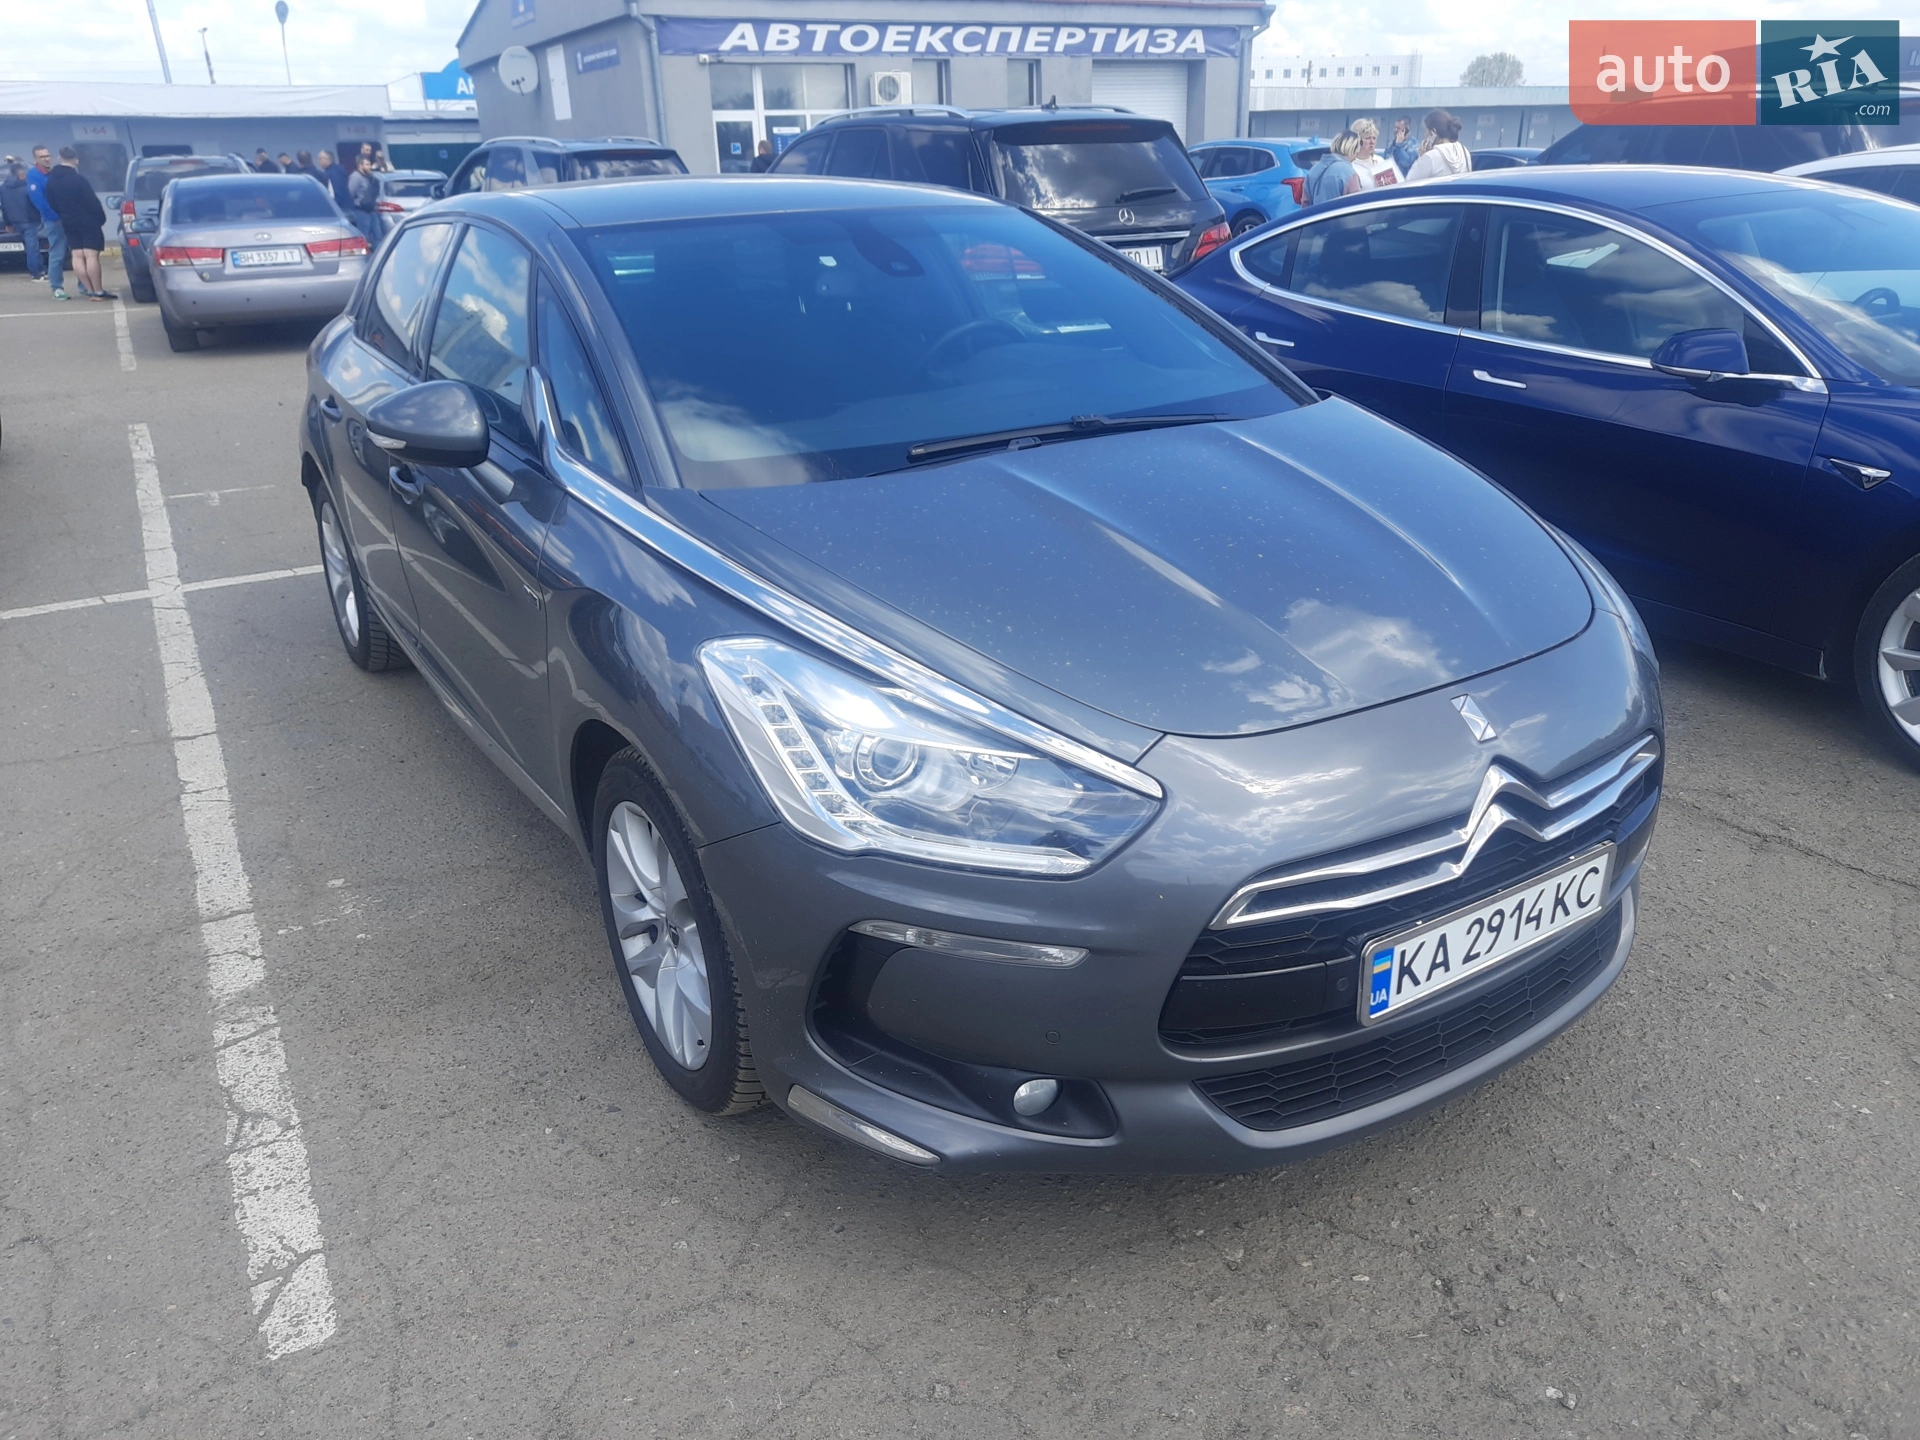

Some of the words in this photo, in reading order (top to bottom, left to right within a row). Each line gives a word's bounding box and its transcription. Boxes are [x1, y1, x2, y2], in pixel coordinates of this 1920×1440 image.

[718, 22, 1207, 54] АВТОЕКСПЕРТИЗА
[256, 251, 279, 262] 3357
[1396, 932, 1451, 995] KA
[1461, 888, 1546, 966] 2914
[1550, 866, 1600, 925] KC
[1370, 988, 1388, 1006] UA
